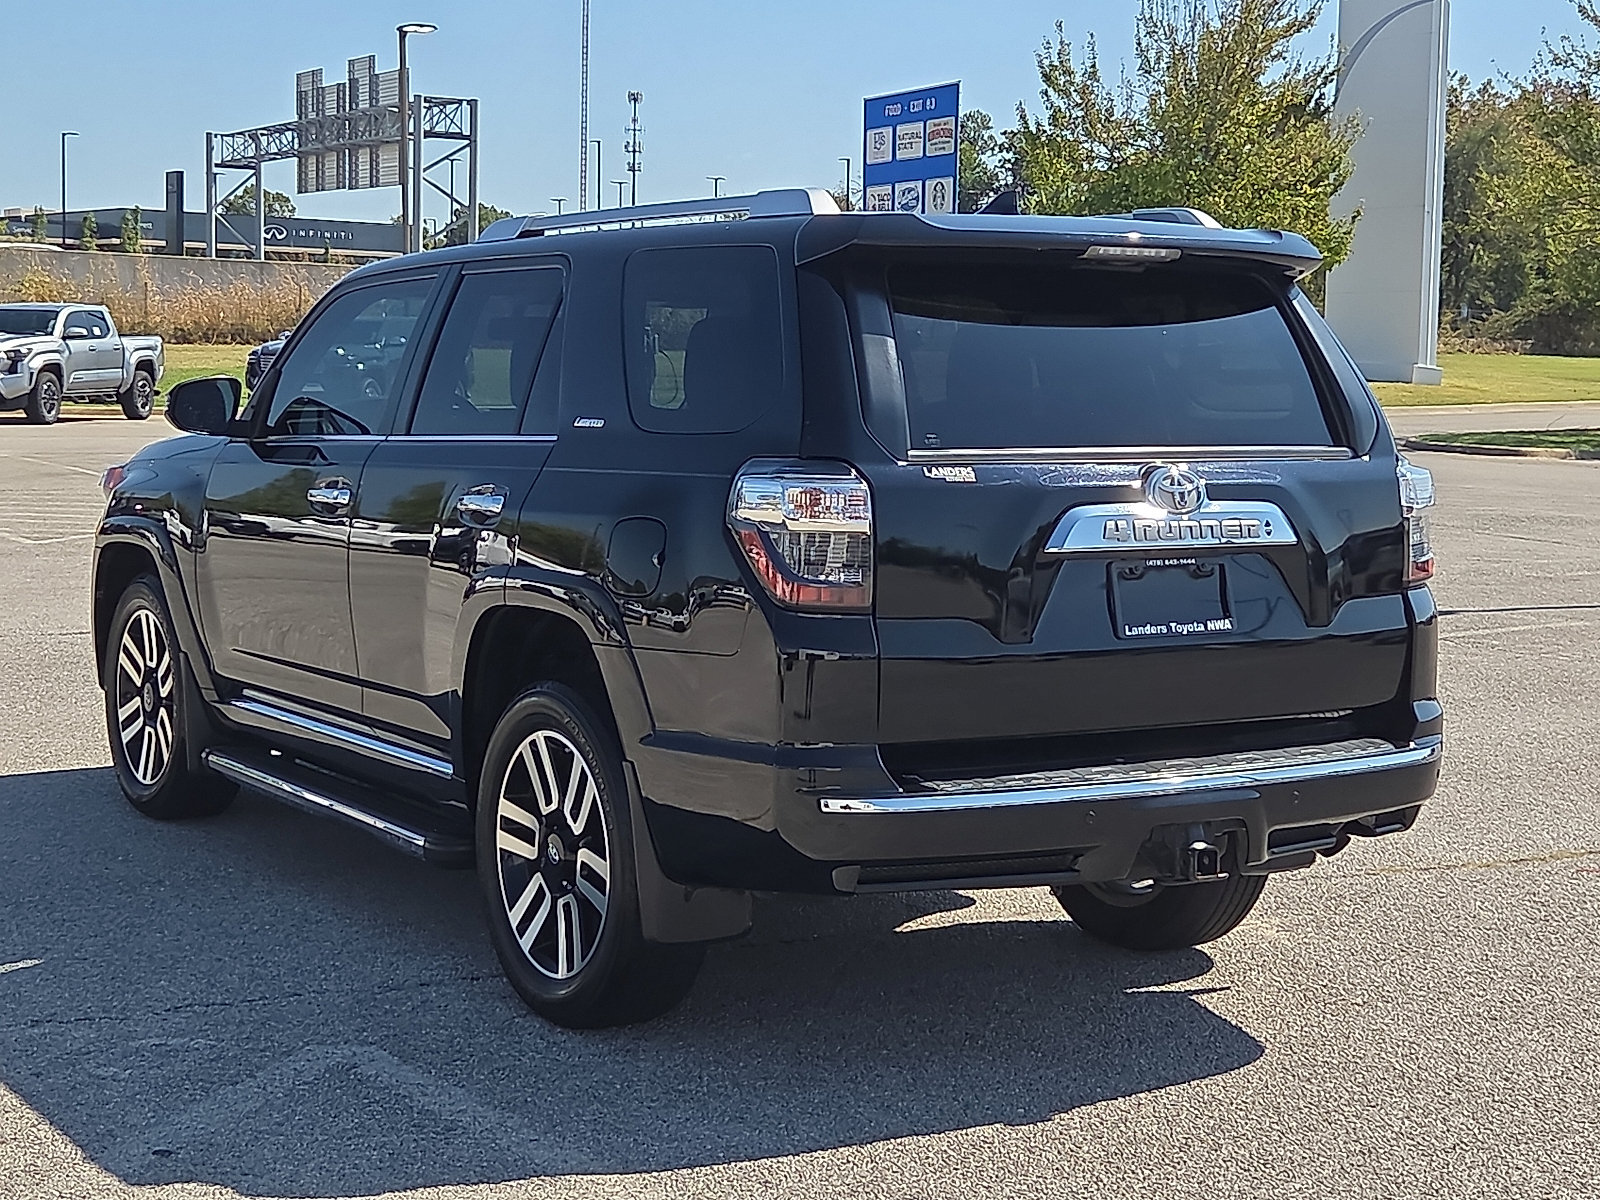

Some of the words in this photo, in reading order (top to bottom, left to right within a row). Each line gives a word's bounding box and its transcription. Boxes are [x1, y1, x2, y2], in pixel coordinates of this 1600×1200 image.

[910, 99, 923, 112] EXIT
[292, 229, 353, 240] INFINITI
[922, 466, 975, 478] LANDERS
[1124, 624, 1167, 636] Landers
[1169, 621, 1205, 635] Toyota
[1206, 618, 1233, 631] NWA
